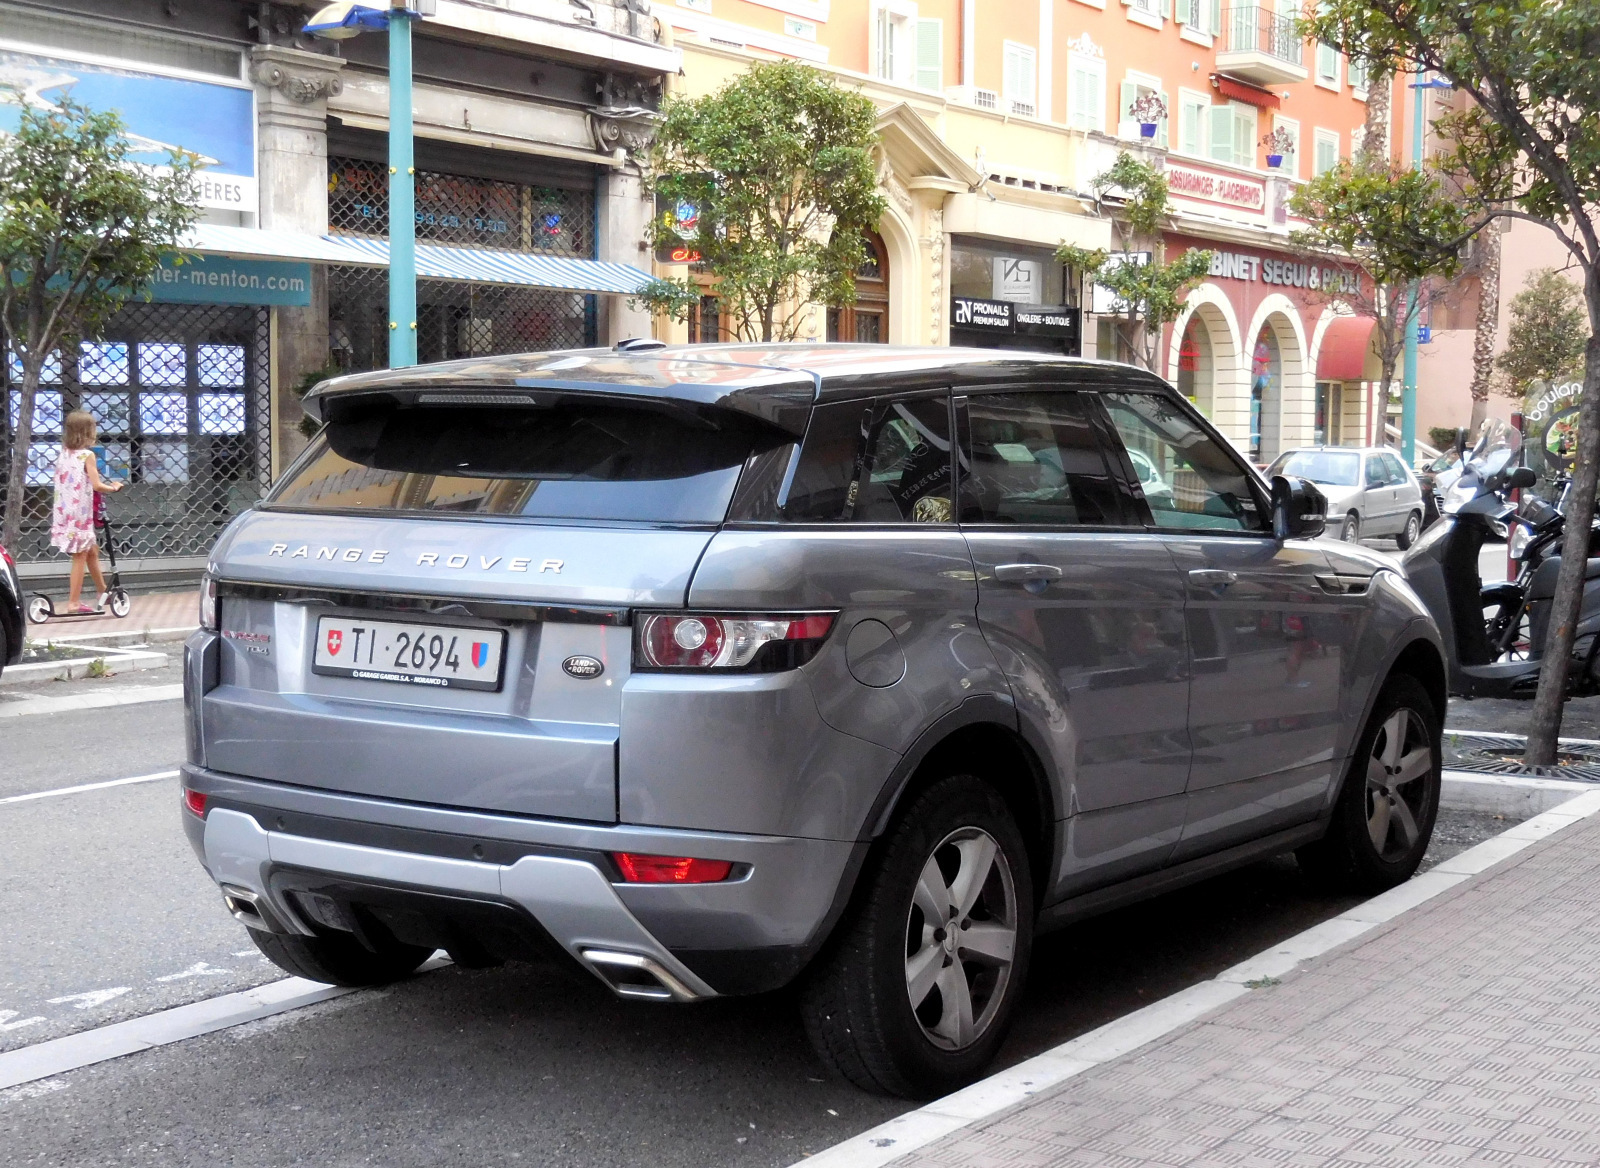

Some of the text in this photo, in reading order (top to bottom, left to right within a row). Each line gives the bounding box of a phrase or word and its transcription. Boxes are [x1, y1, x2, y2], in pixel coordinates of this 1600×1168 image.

[1169, 169, 1214, 195] ASSURANCES
[1219, 180, 1261, 204] PLACEMENTS
[1262, 258, 1308, 288] SEGUI
[1309, 266, 1320, 290] &
[973, 303, 1009, 317] PRONAILS
[973, 316, 1010, 327] PREMIUM SALON
[1016, 313, 1071, 327] ONGLERIE BOUTIQUE
[268, 542, 566, 575] RANGE ROVER
[352, 627, 460, 673] TI 2694
